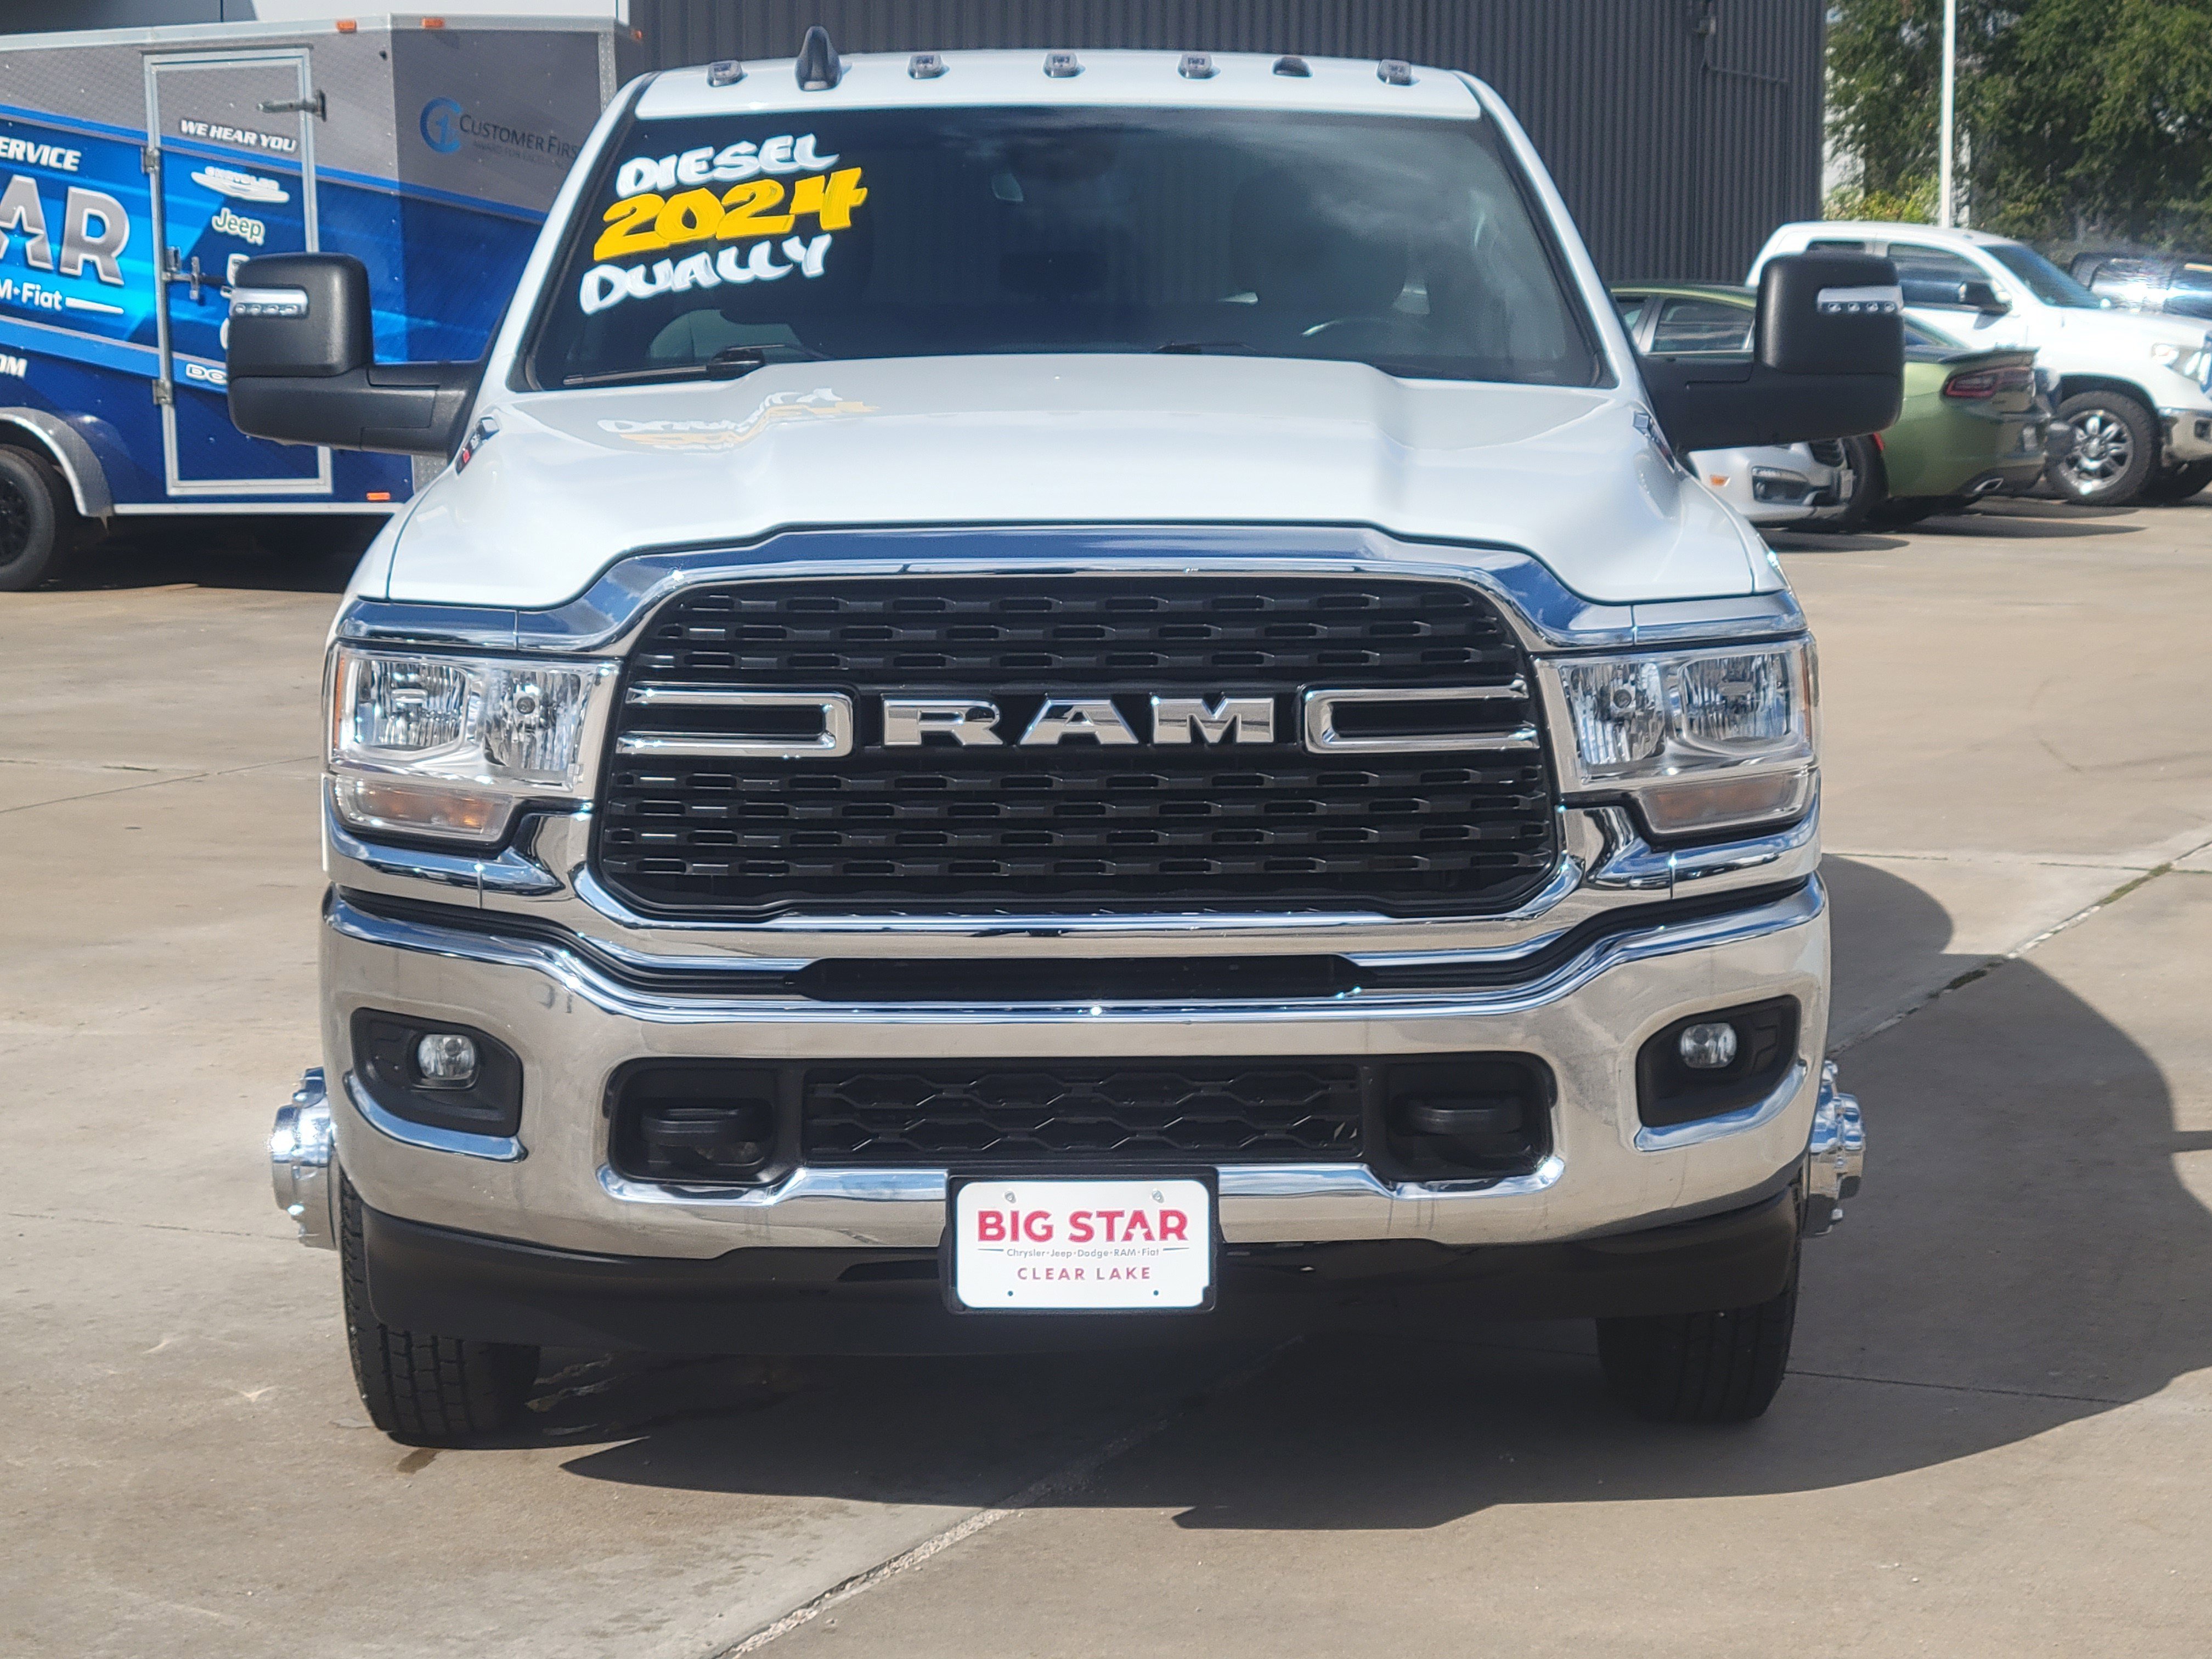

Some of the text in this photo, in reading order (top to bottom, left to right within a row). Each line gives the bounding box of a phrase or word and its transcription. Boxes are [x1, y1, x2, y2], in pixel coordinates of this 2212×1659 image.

[181, 119, 296, 153] WE HEAR YOU
[460, 114, 582, 160] CUSTOMER FIRS
[616, 133, 840, 198] DIESEL
[212, 208, 264, 243] Jeep
[594, 167, 867, 261] 2024
[579, 233, 833, 315] DUALLY
[882, 697, 1275, 746] RAM
[977, 1209, 1189, 1243] BIG STAR
[1017, 1267, 1150, 1280] CLEAR LAKE
